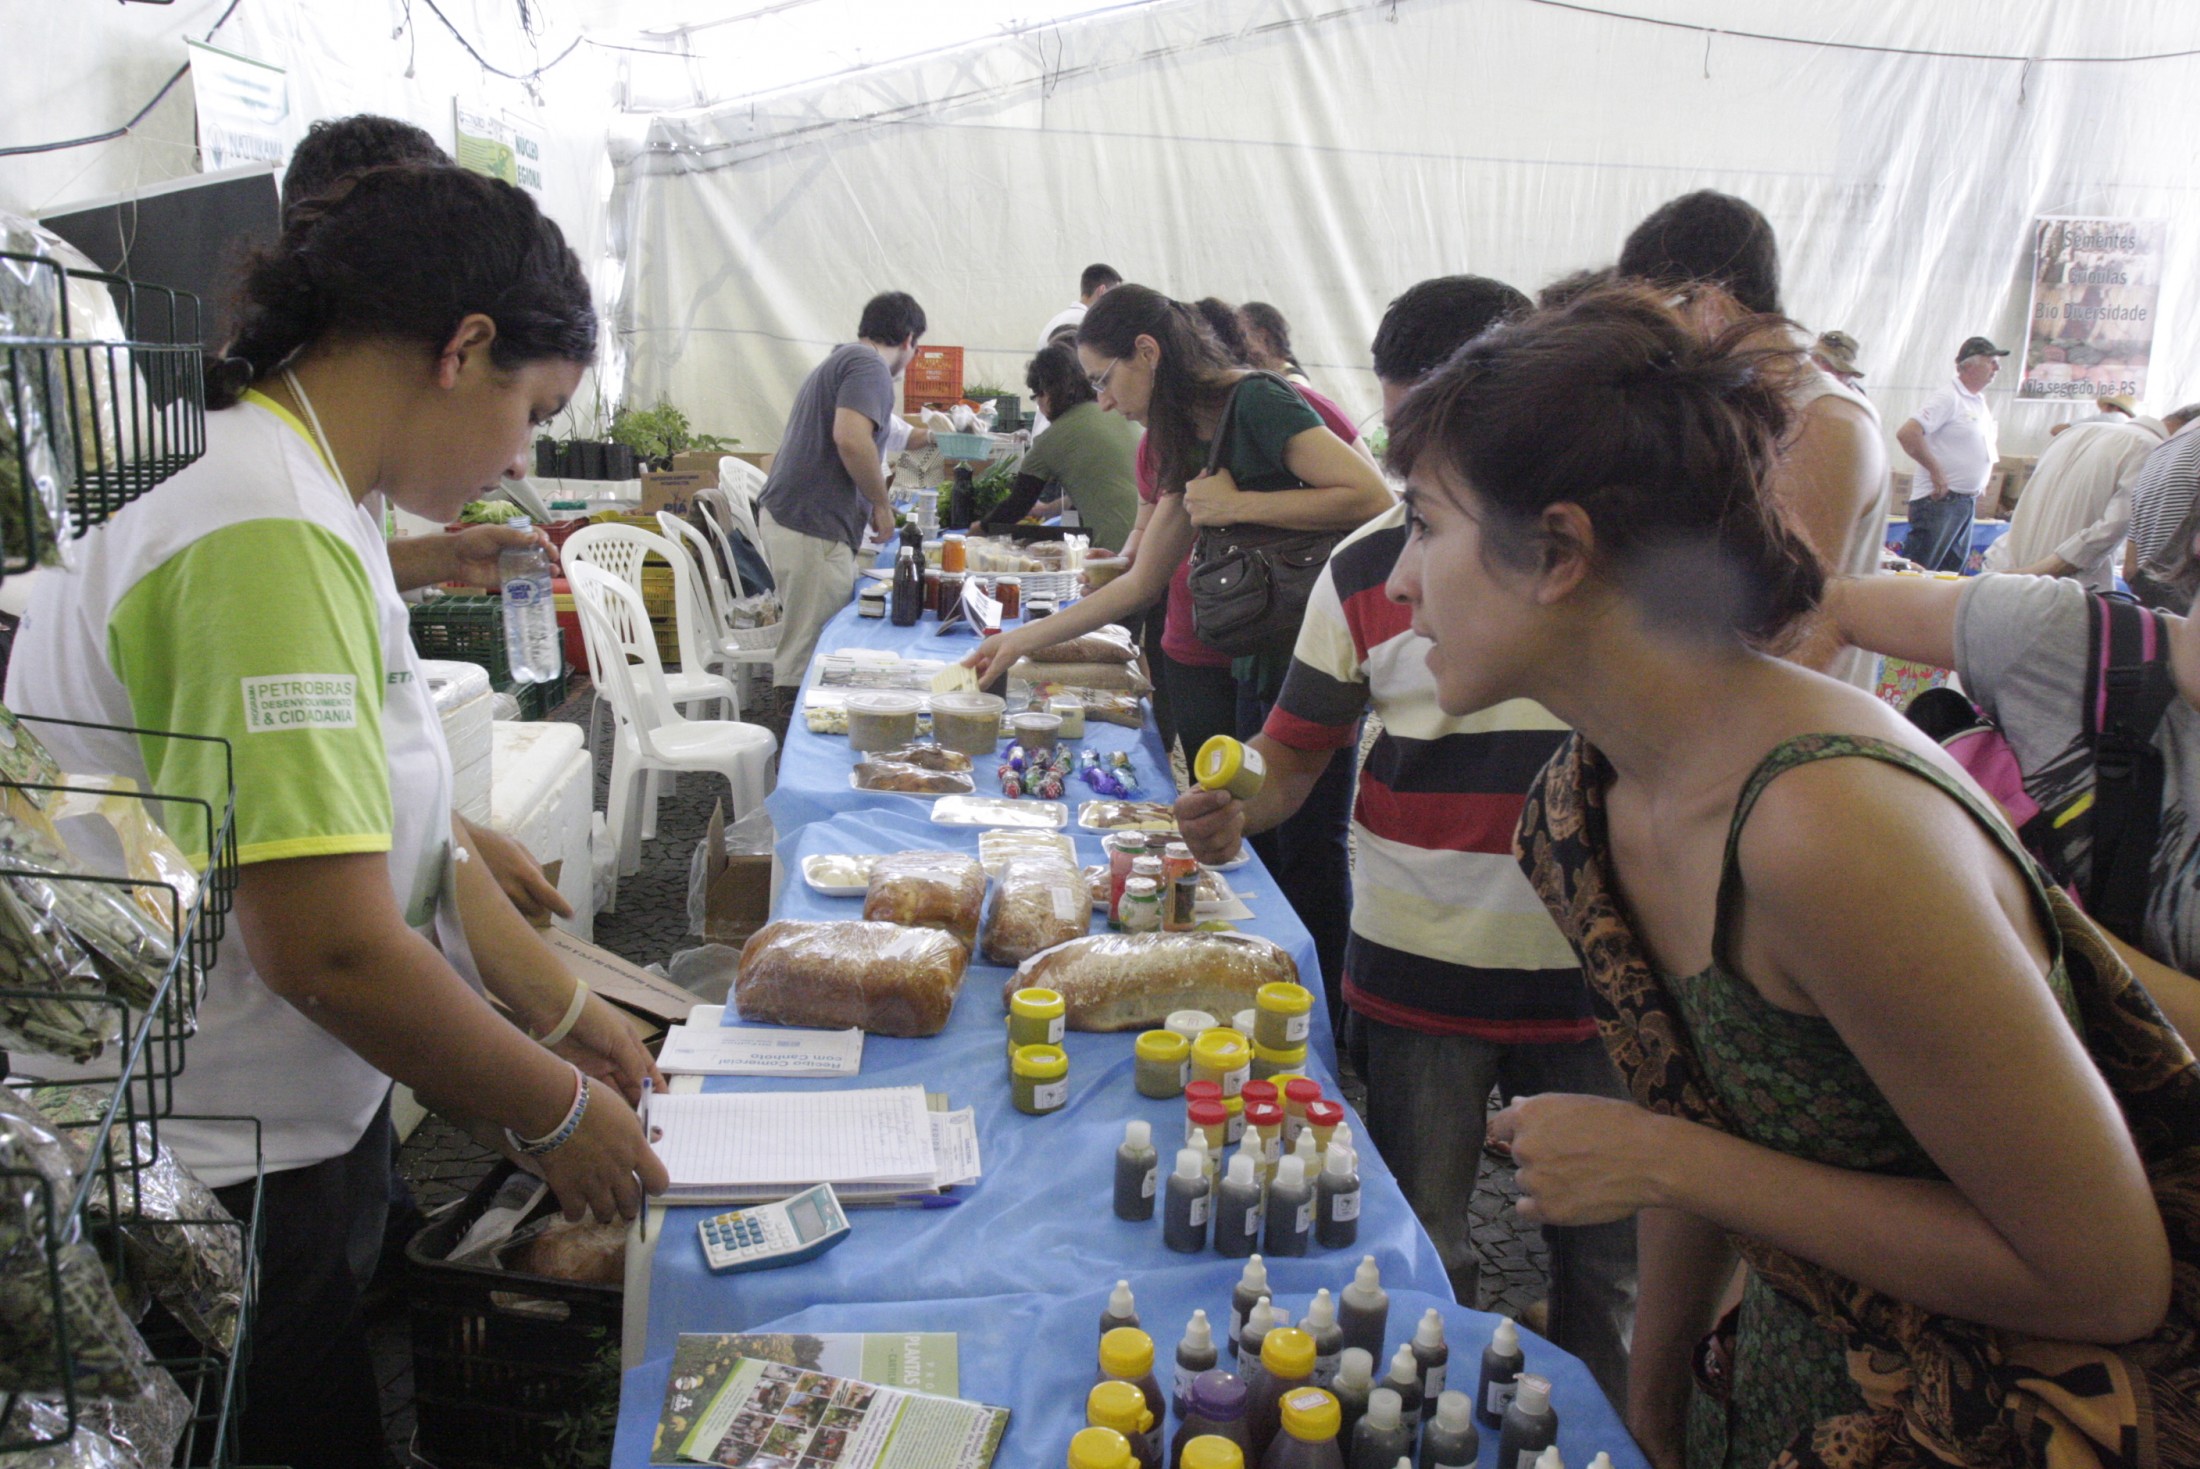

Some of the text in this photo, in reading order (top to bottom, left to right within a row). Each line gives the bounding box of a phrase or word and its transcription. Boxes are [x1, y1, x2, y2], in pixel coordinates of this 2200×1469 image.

[517, 164, 542, 191] EGIONAL
[2063, 230, 2136, 249] Sementes
[2035, 302, 2147, 321] Bio Diversidade
[2047, 379, 2094, 397] segredo
[258, 681, 352, 698] PETROBRAS
[260, 699, 351, 710] DESENVOLVIMENTO
[263, 709, 352, 726] & CIDADANIA
[718, 1058, 789, 1068] Comercial
[903, 1335, 921, 1385] PLANTAS
